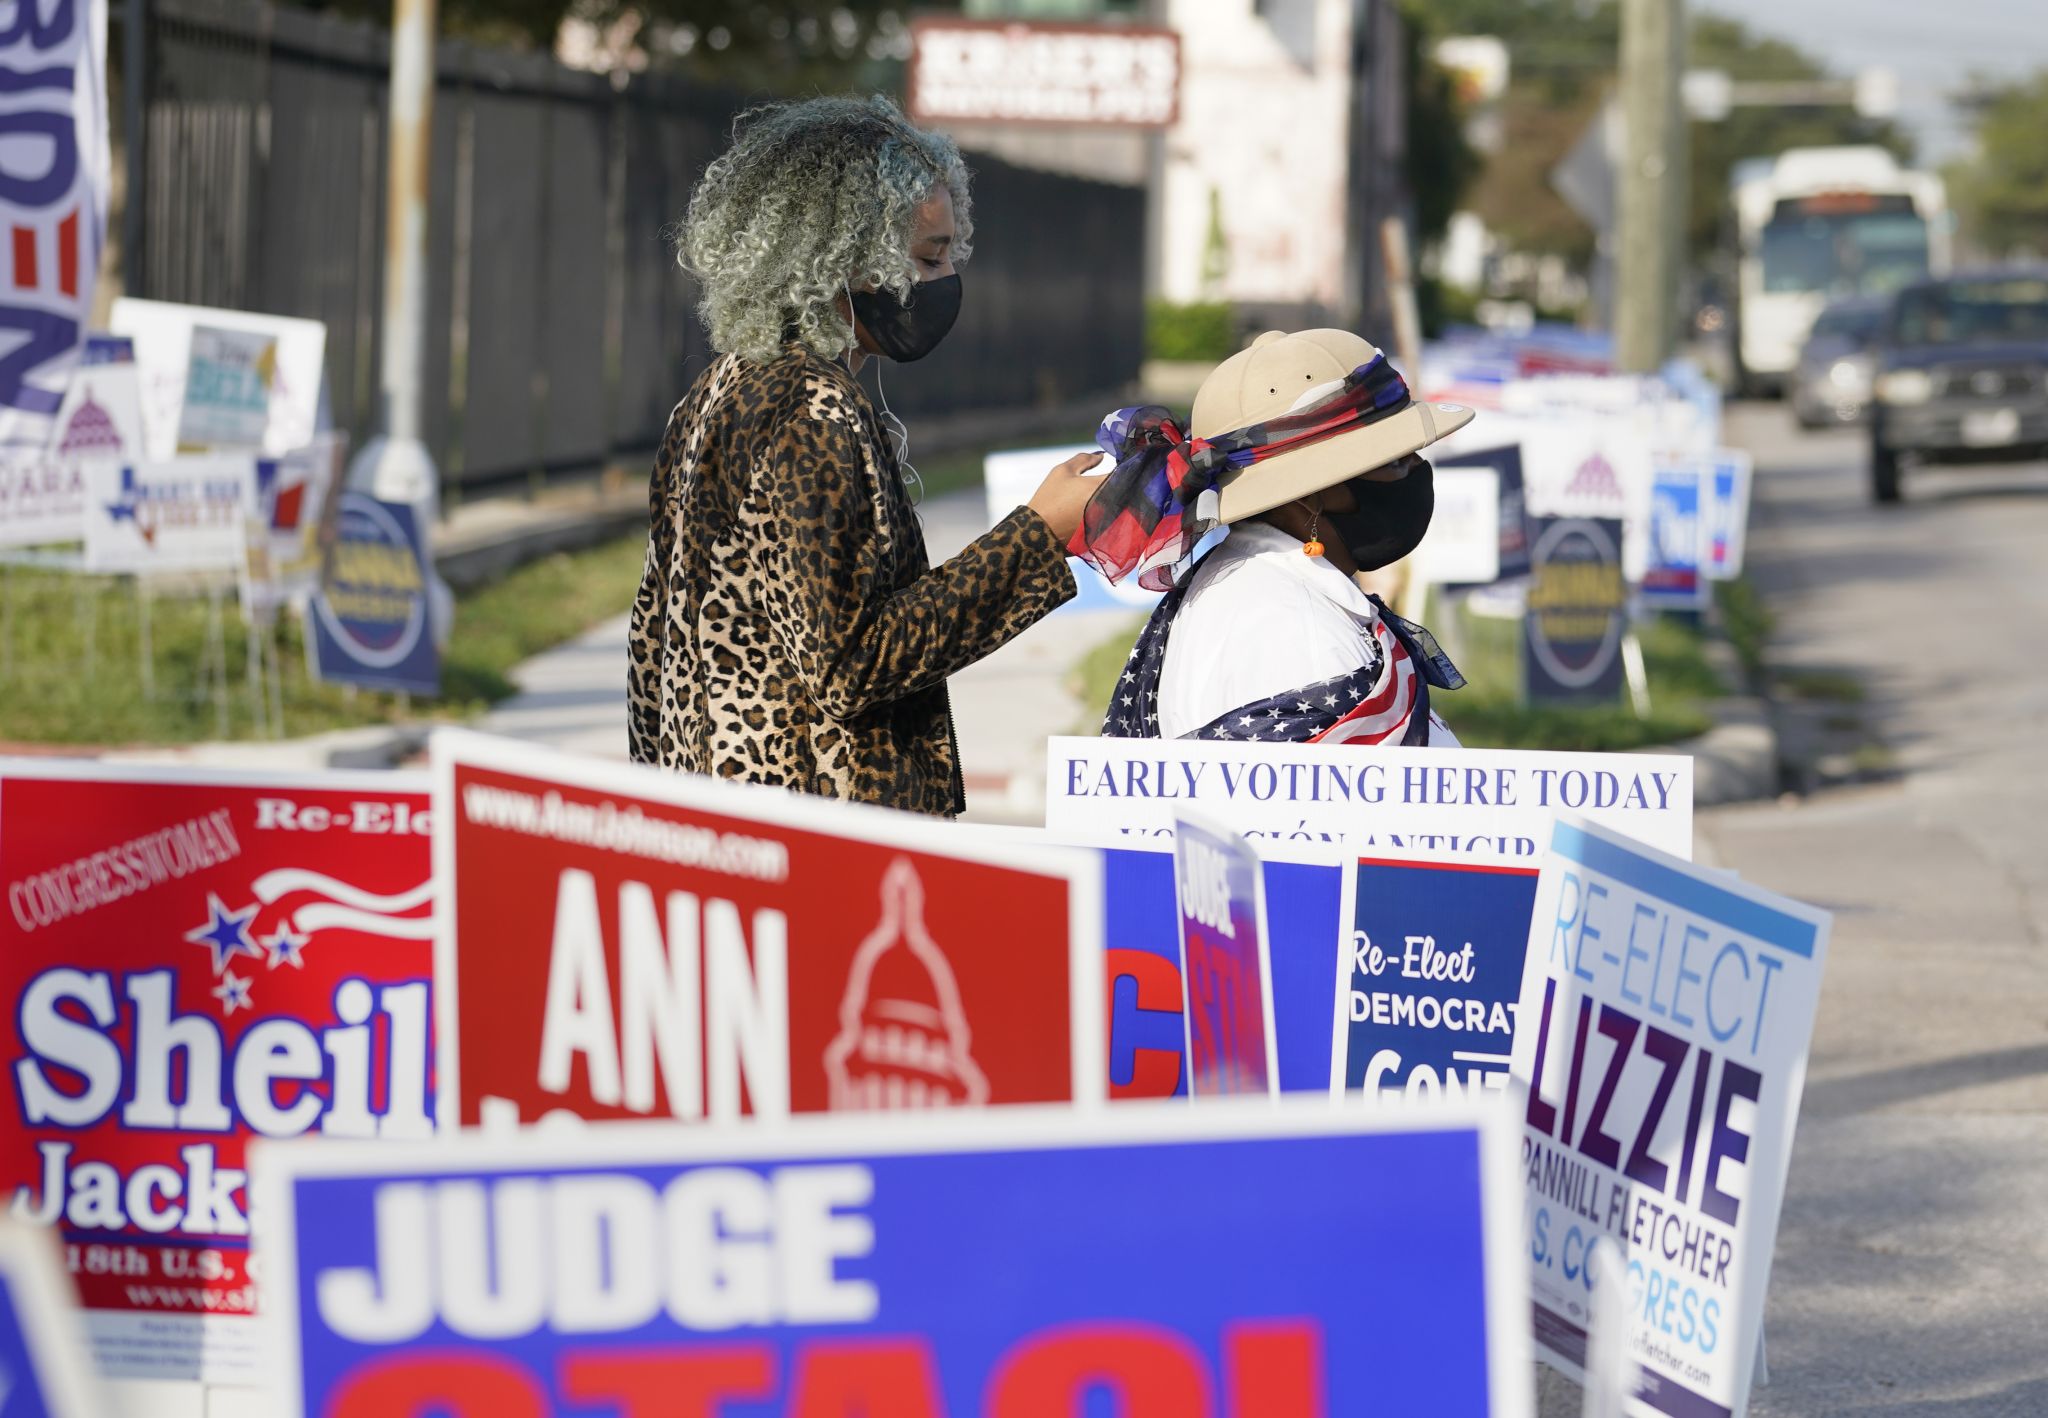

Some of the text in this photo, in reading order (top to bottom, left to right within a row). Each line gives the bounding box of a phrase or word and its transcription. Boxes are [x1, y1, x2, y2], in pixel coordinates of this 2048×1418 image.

[1066, 758, 1678, 810] EARLY VOTING HERE TODAY
[9, 808, 242, 932] CONGRESSWOMAN
[537, 866, 791, 1122] ANN
[1352, 930, 1476, 984] Re-Elect
[1550, 871, 1784, 1056] RE-ELECT
[1524, 977, 1762, 1228] LIZZIE
[68, 1244, 150, 1277] 18th
[160, 1248, 235, 1281] U.S.
[315, 1162, 880, 1344] JUDGE
[1522, 1134, 1732, 1288] PANNILL FLETCHER
[1531, 1206, 1552, 1270] S.
[1562, 1224, 1720, 1354] COGRESS
